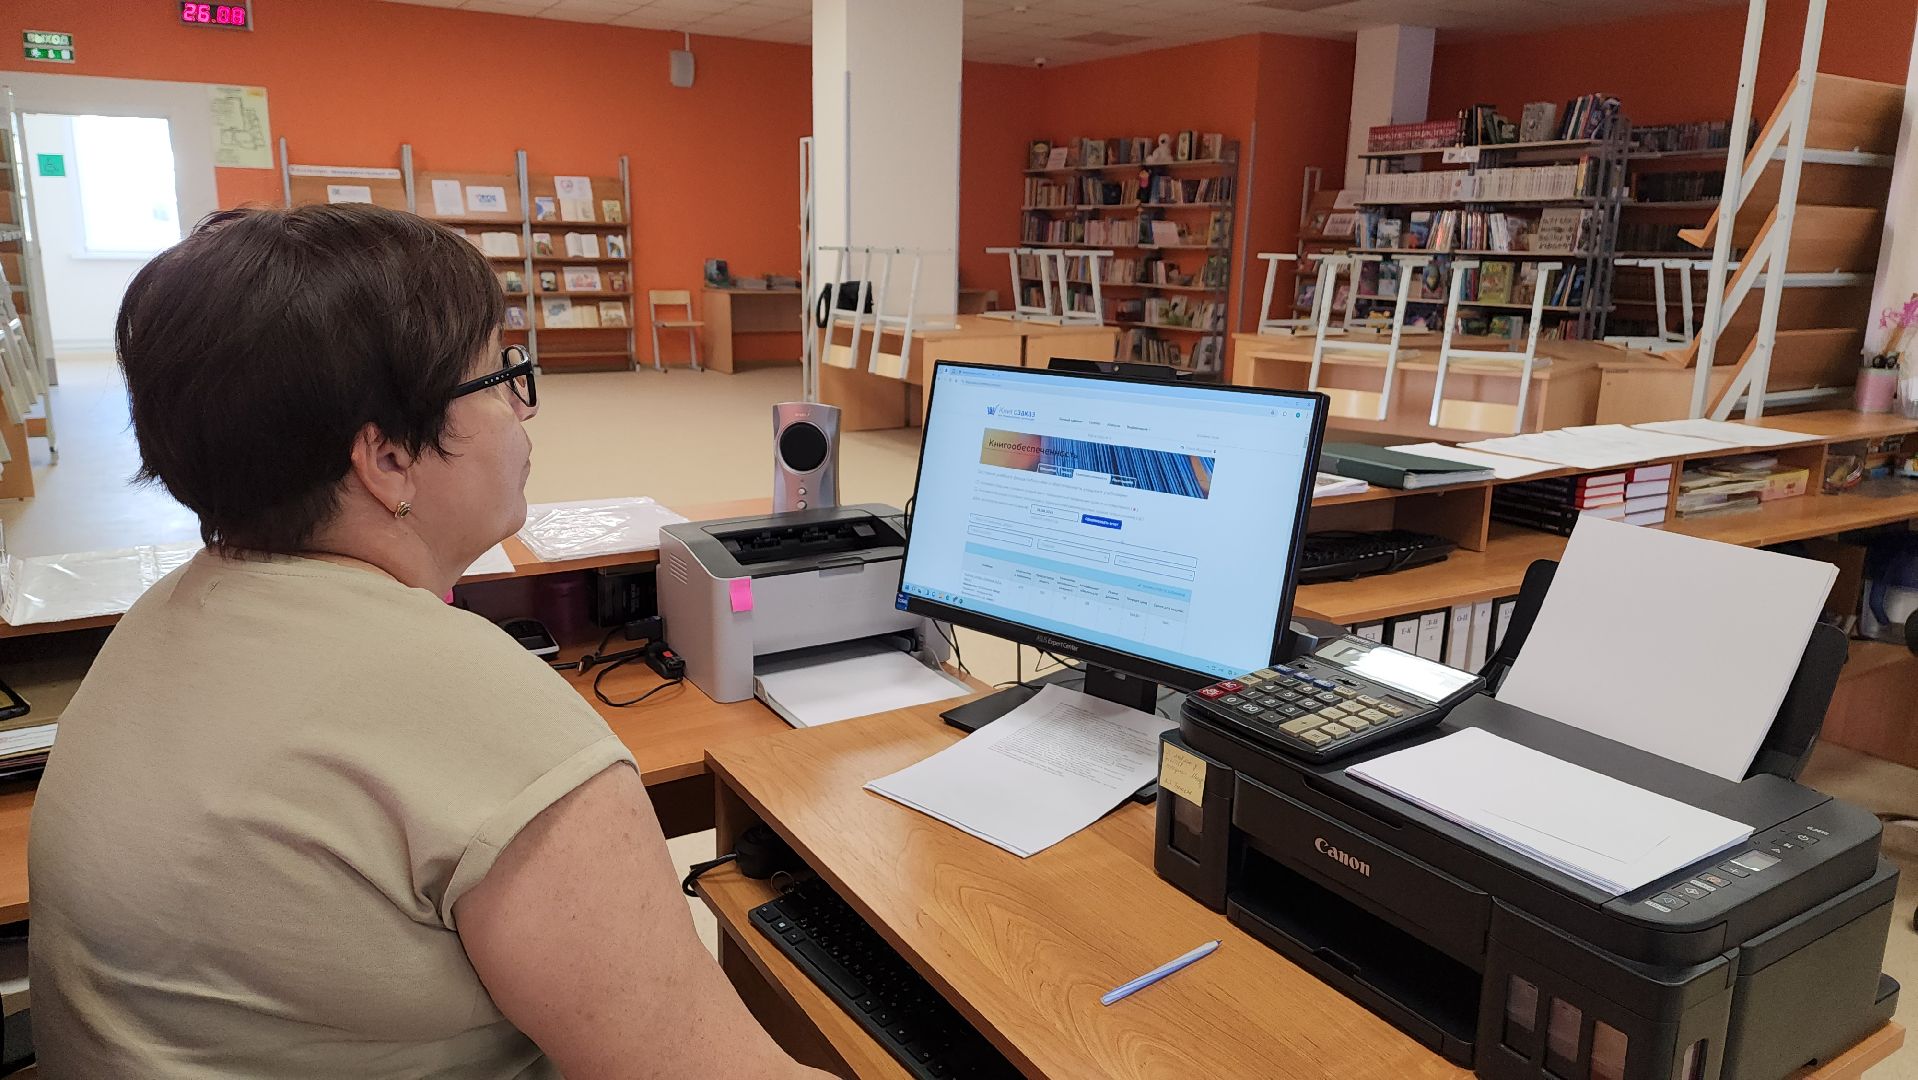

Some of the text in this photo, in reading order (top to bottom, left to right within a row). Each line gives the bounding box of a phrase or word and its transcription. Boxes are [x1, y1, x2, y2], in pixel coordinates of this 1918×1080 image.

[183, 3, 245, 26] 26.08
[988, 439, 1078, 459] Книгообеспеченность
[1047, 638, 1079, 651] ExpertCenter
[1314, 837, 1370, 878] Canon
